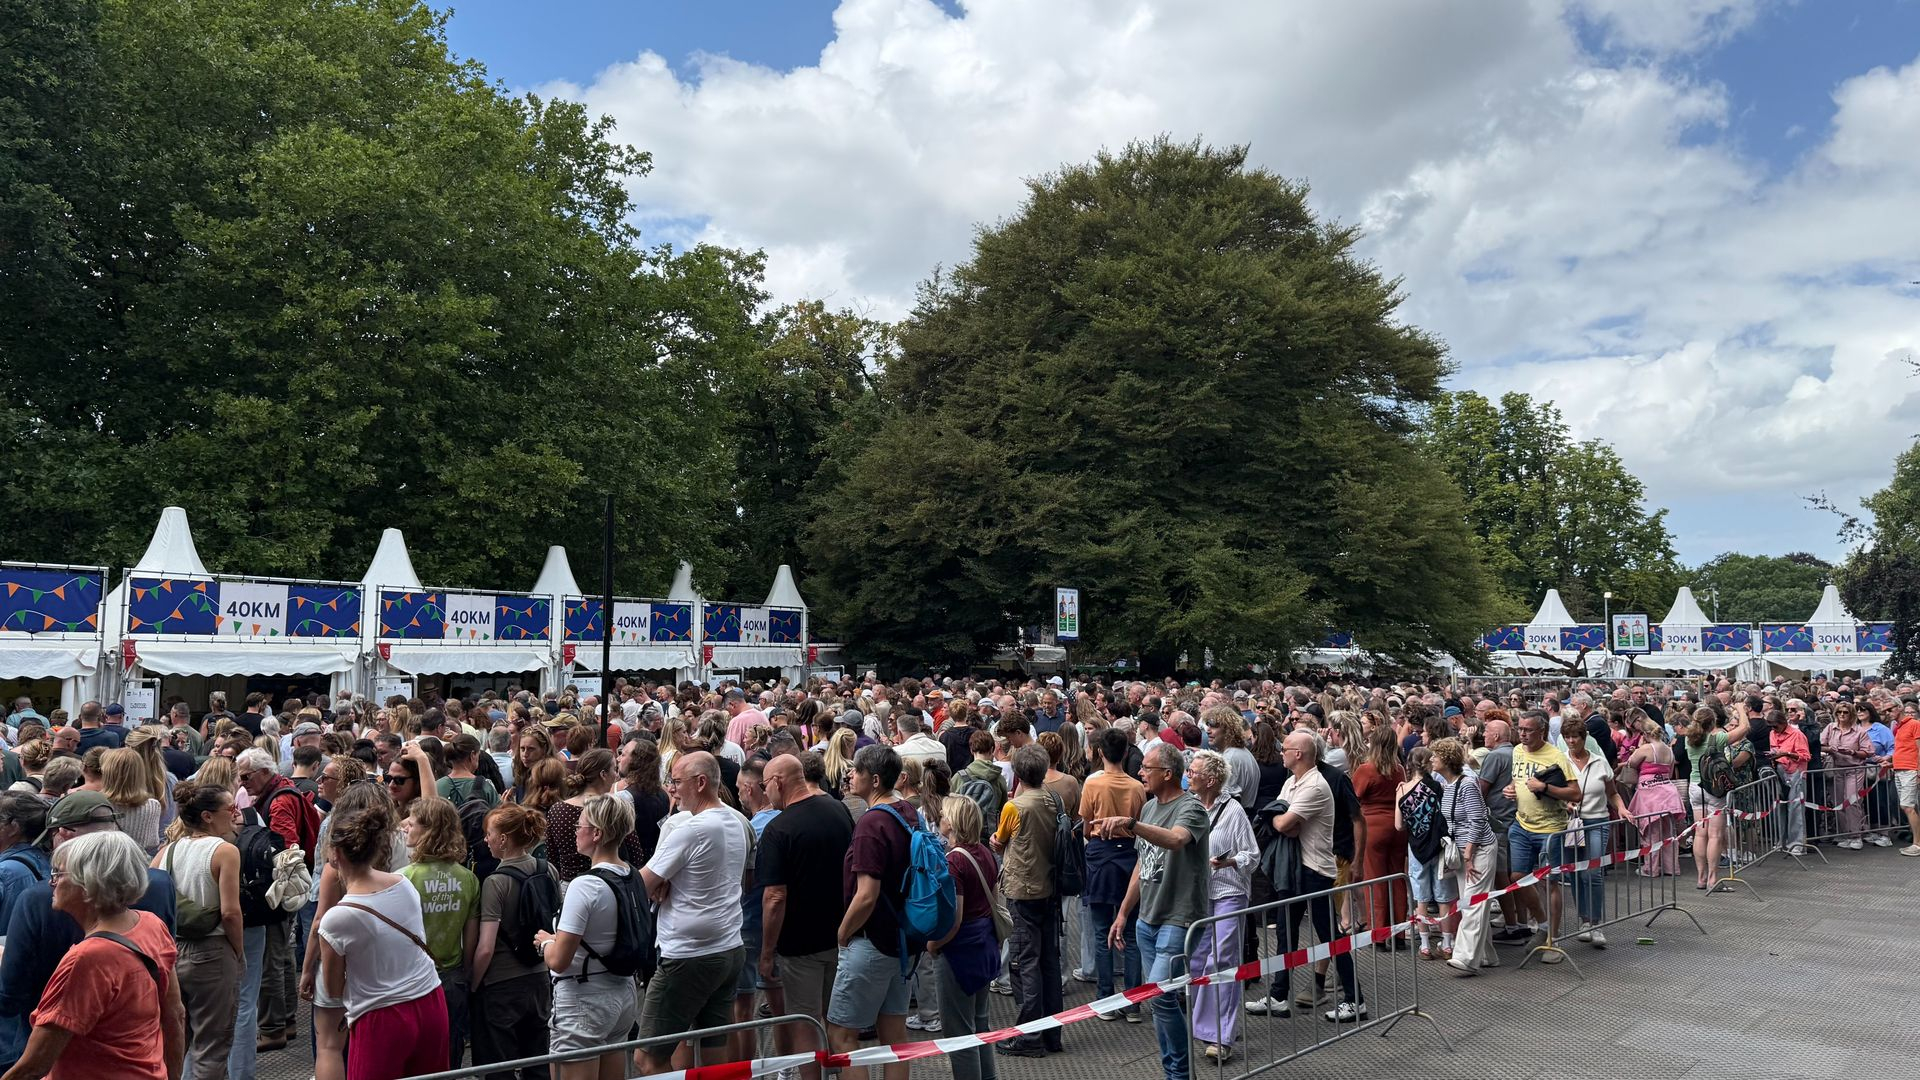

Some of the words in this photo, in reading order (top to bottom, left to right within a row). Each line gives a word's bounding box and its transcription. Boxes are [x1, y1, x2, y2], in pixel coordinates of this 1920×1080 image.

[226, 601, 280, 618] 40KM
[451, 610, 491, 625] 40KM
[617, 615, 647, 629] 40KM
[743, 619, 767, 632] 40KM
[1528, 634, 1557, 643] 30KM
[1667, 635, 1697, 644] 30KM
[1818, 635, 1852, 644] 30KM
[437, 871, 451, 879] The
[424, 878, 462, 893] Walk
[431, 893, 441, 902] of
[440, 893, 454, 901] the
[423, 900, 461, 913] World
